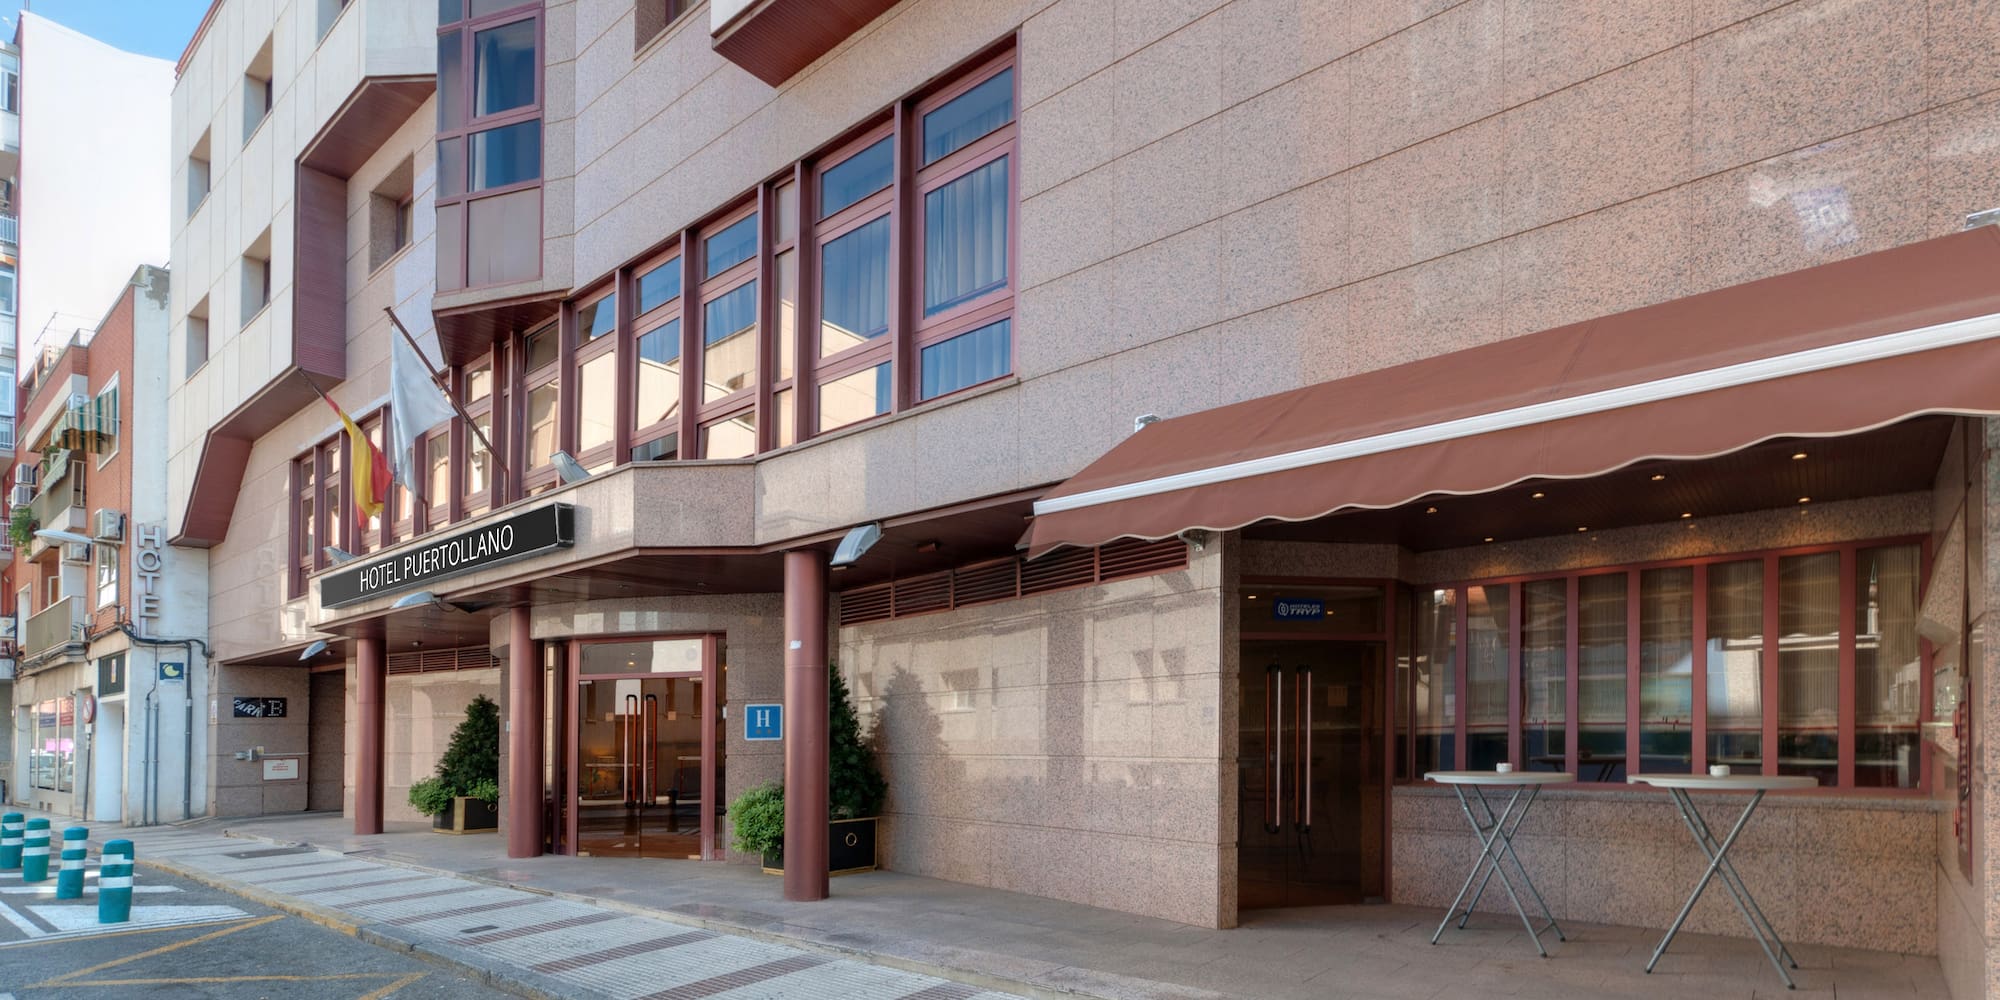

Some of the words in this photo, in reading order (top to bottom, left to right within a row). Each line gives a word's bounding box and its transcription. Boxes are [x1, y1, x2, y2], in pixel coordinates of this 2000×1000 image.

[137, 522, 161, 640] HOTEL
[360, 560, 401, 592] HOTEL
[404, 524, 514, 580] PUERTOLLANO
[756, 709, 770, 728] H
